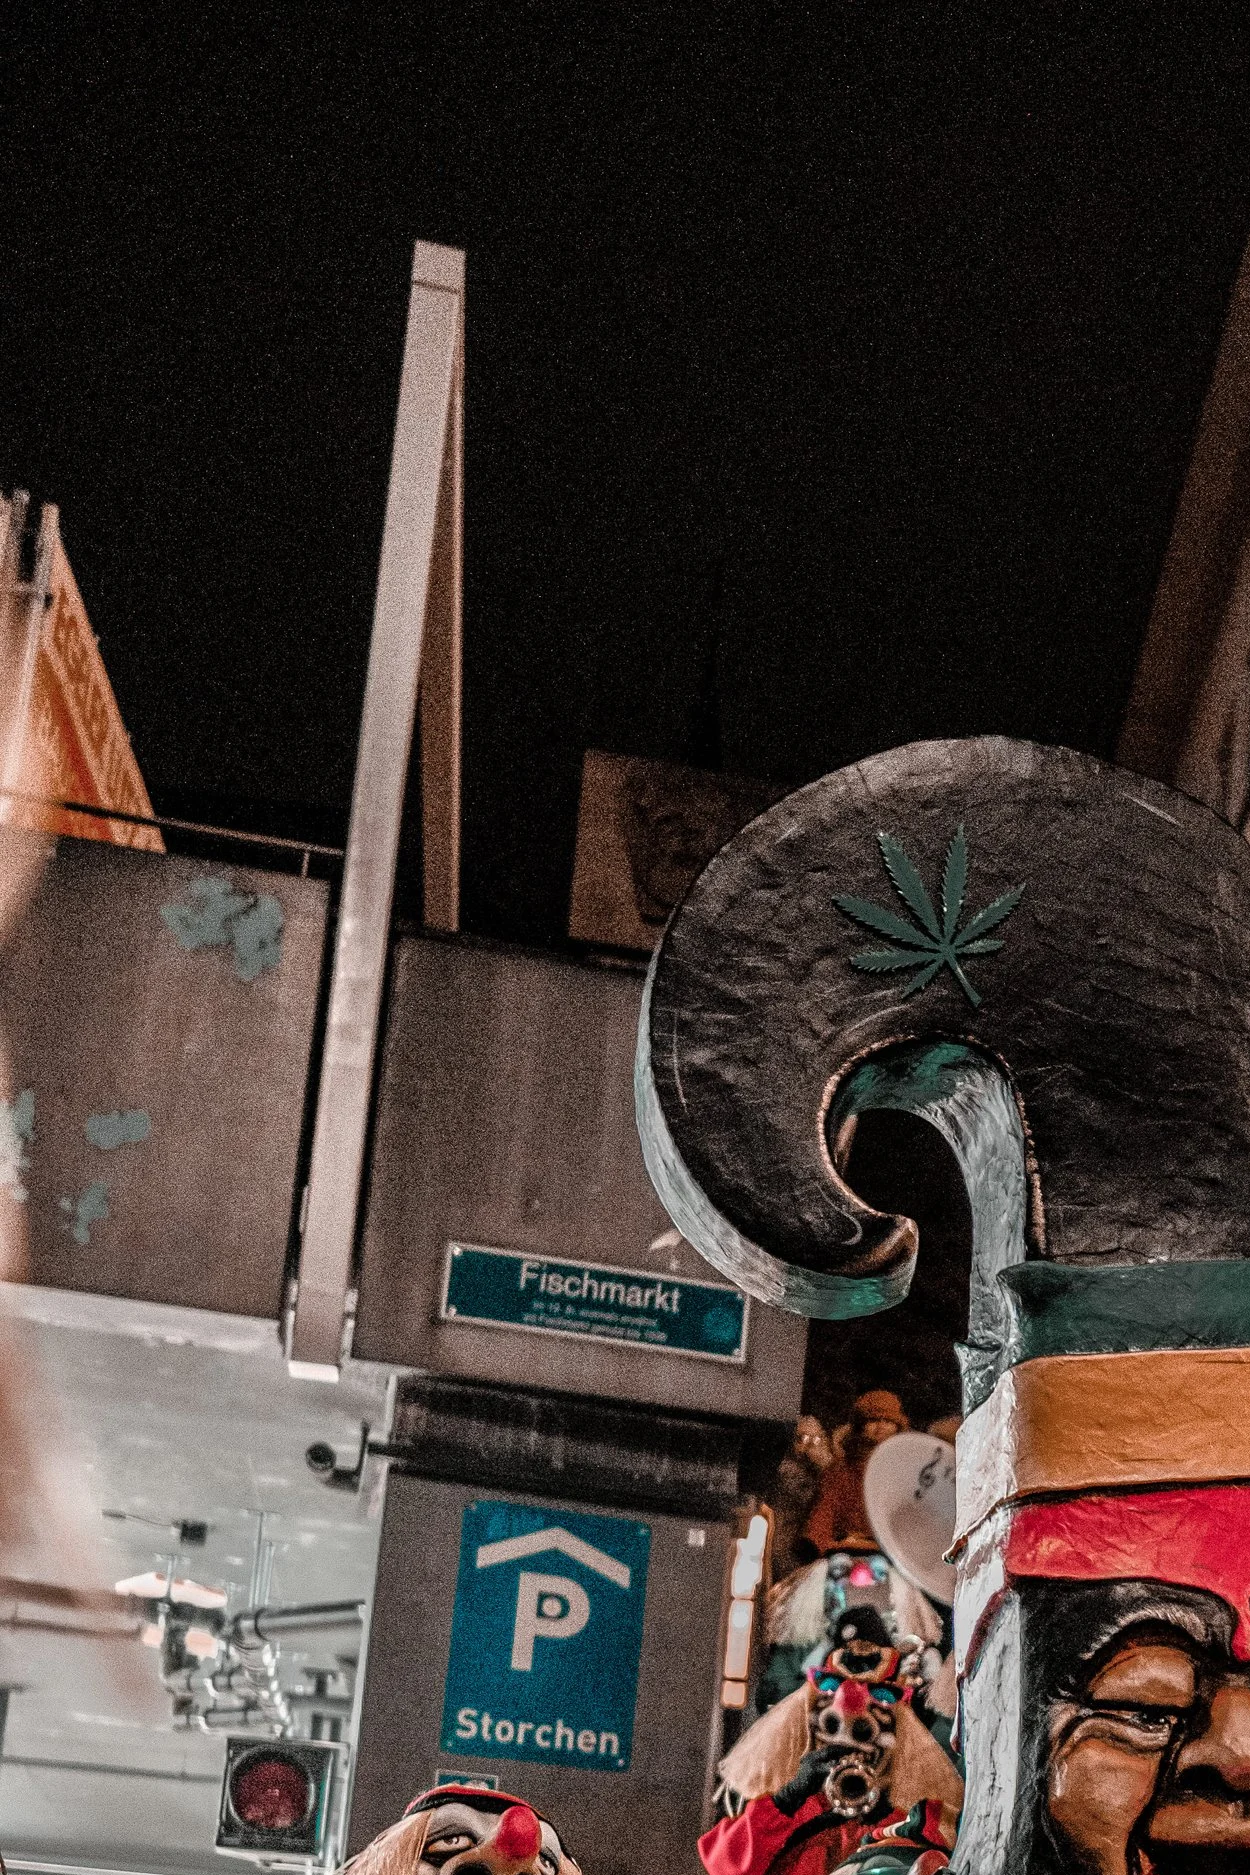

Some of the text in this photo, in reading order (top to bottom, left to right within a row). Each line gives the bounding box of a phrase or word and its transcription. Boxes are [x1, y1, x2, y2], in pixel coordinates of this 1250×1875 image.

[519, 1260, 681, 1314] Fischmarkt
[511, 1571, 590, 1671] P
[455, 1707, 619, 1757] Storchen
